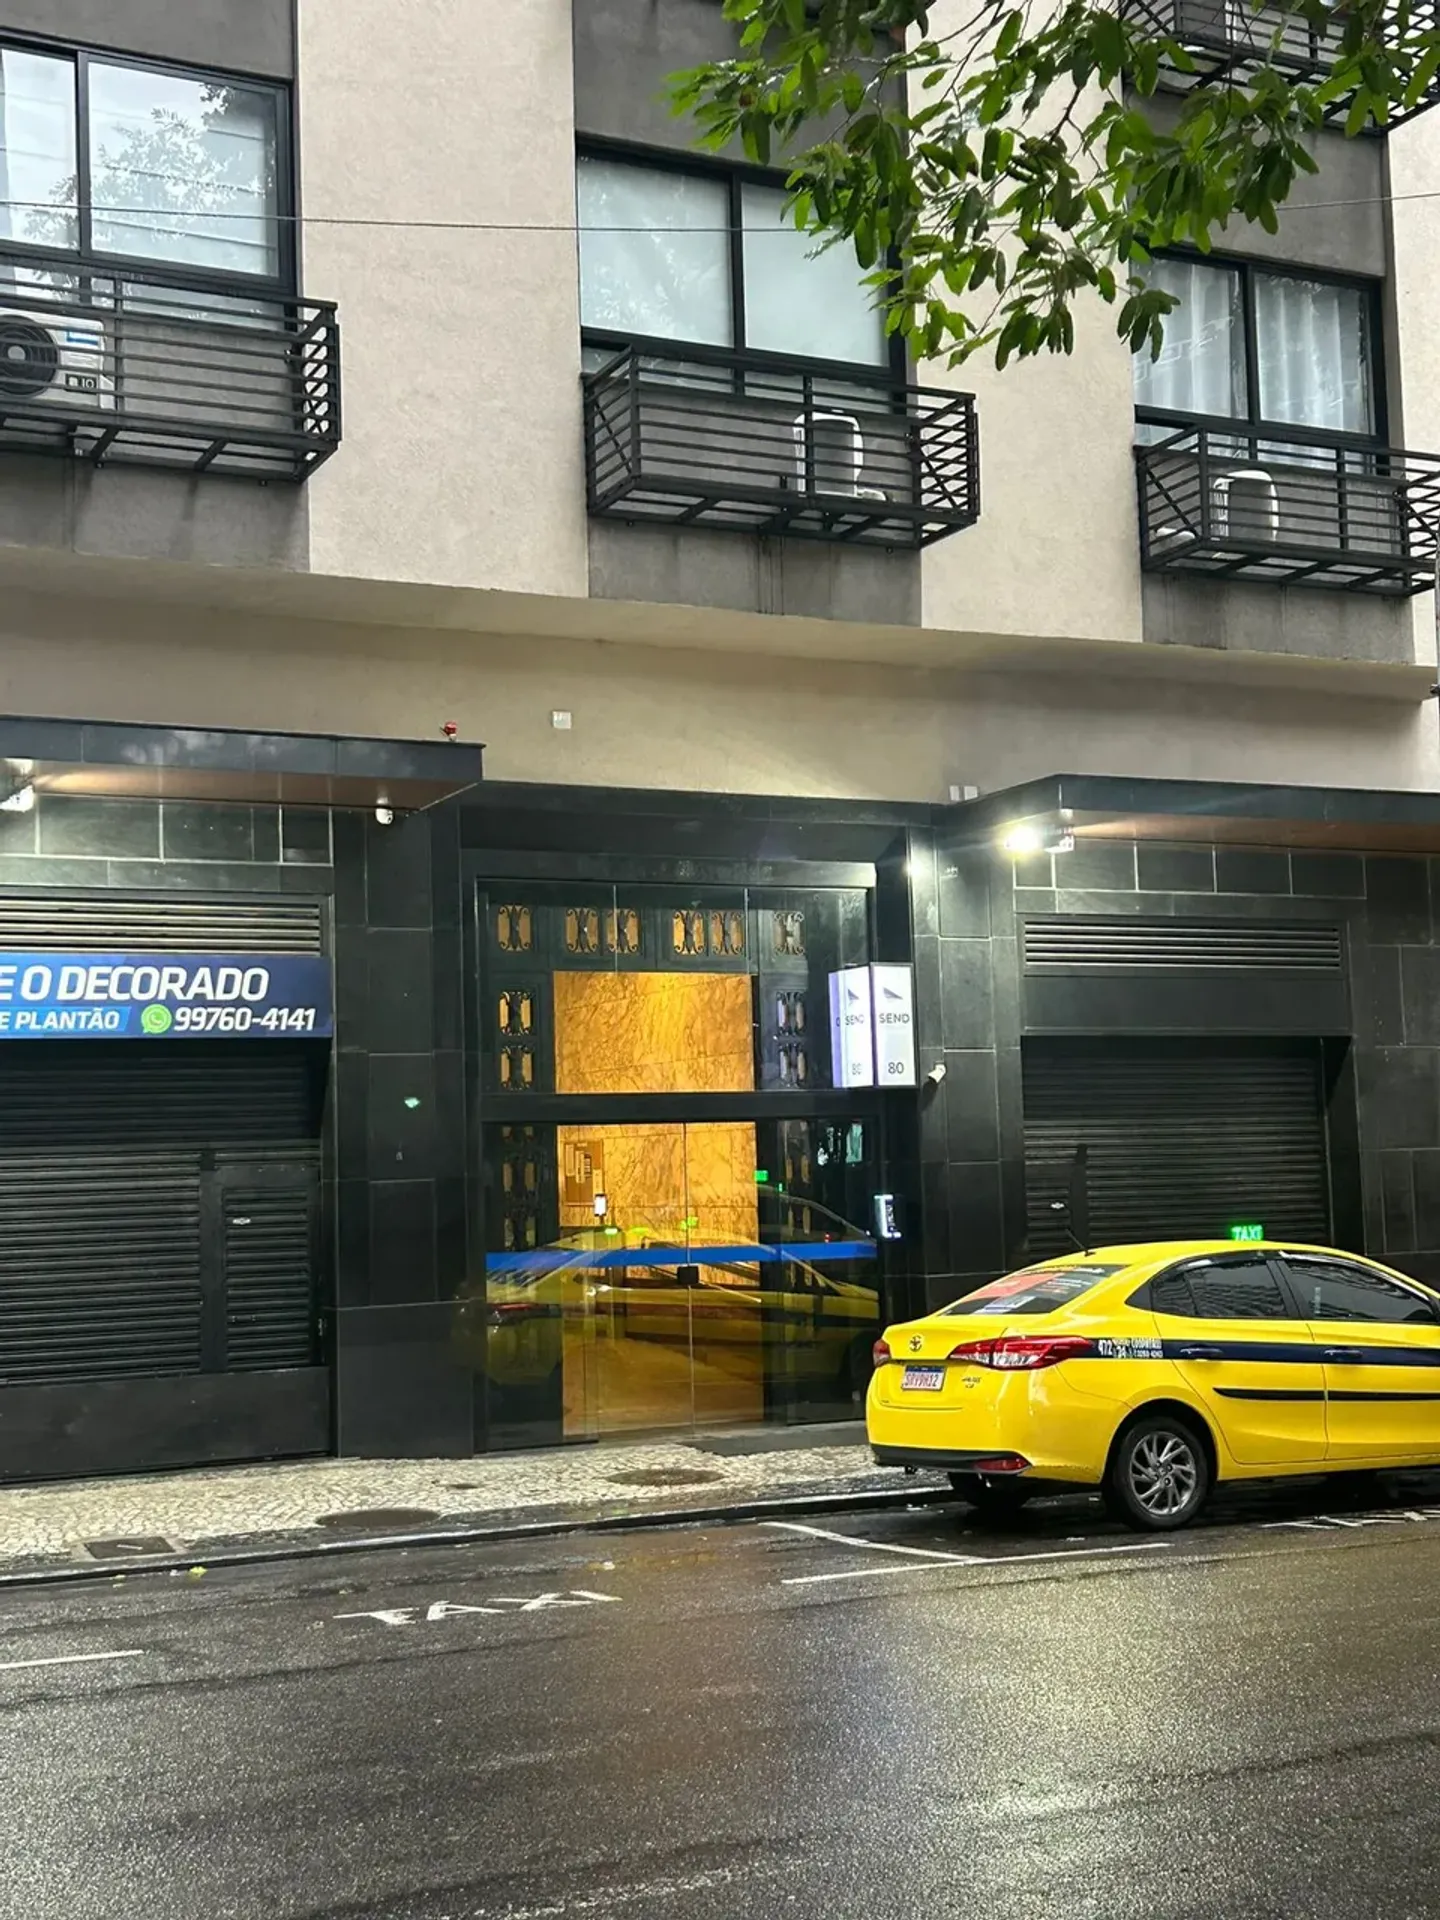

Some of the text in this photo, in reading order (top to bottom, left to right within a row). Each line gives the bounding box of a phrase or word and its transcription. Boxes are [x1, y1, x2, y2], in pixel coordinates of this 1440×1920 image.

[20, 965, 53, 1001] O
[57, 966, 270, 1001] DECORADO
[15, 1007, 120, 1031] PLANTÃO
[174, 1007, 316, 1031] 99760-4141
[879, 1013, 910, 1024] SEND
[888, 1061, 904, 1074] 80
[1231, 1225, 1263, 1241] TAXI
